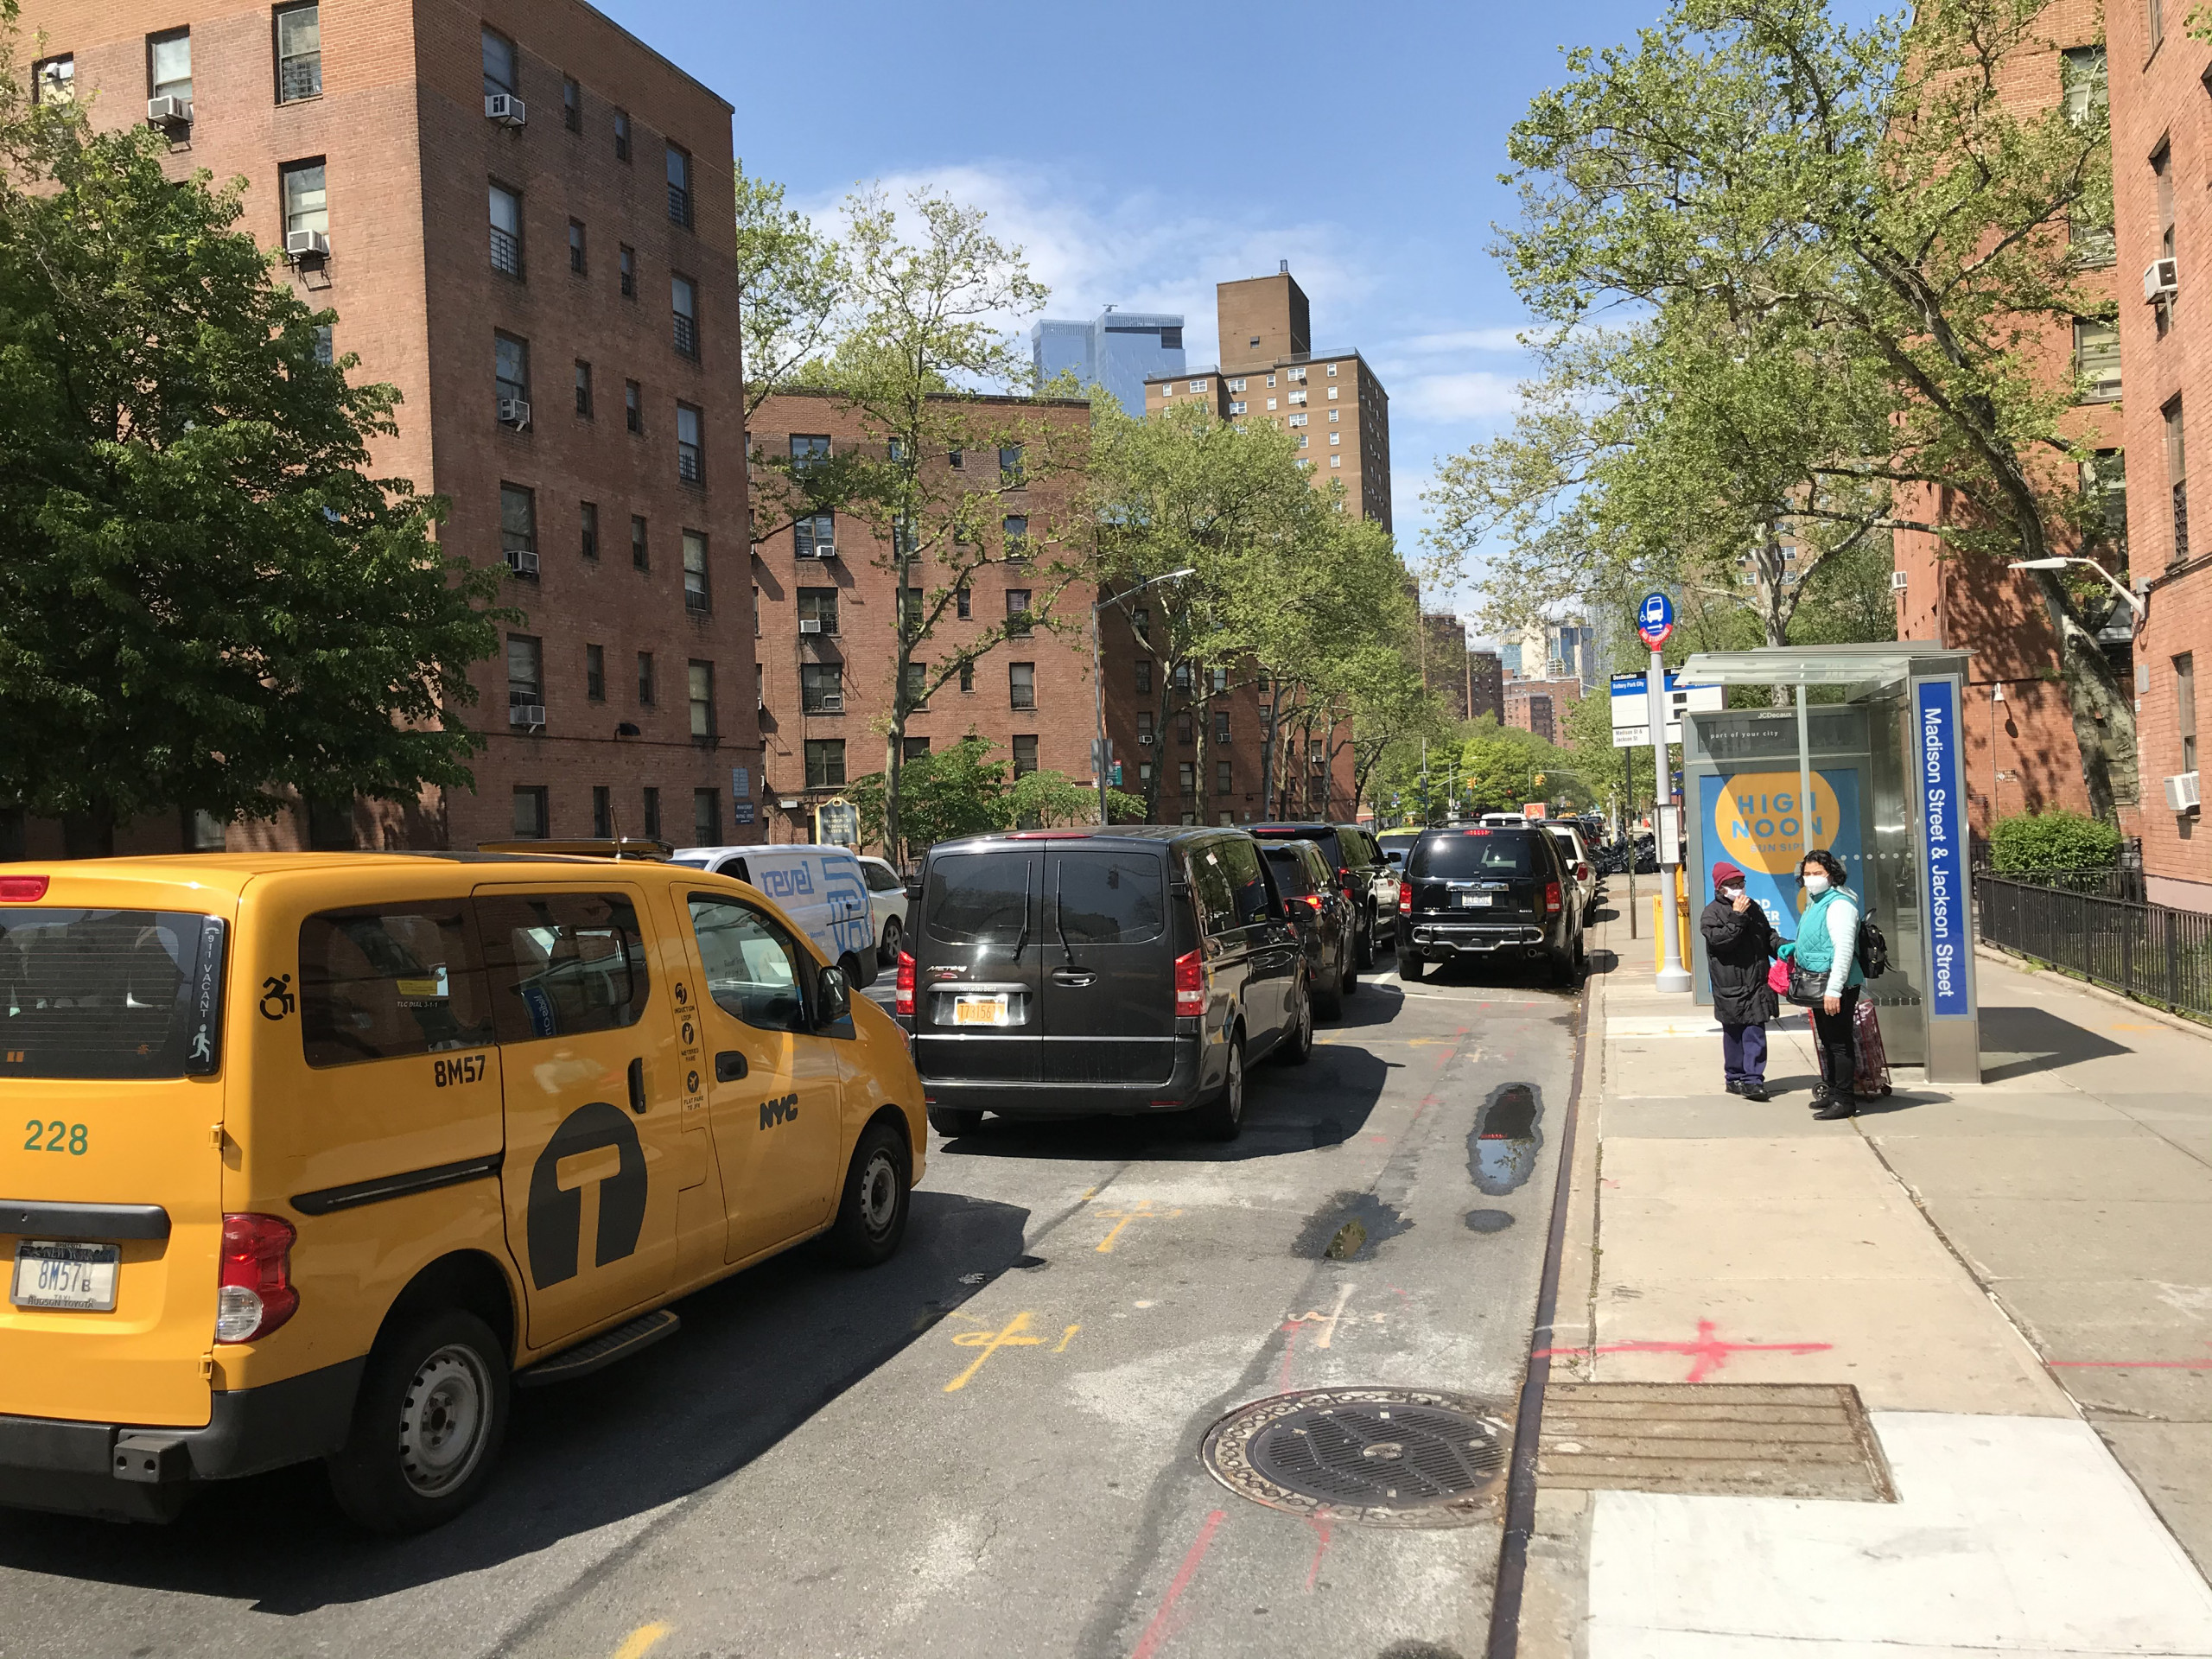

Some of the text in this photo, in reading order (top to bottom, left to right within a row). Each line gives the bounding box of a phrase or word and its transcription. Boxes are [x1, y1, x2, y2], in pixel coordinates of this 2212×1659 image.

[1732, 817, 1822, 839] NOON
[1750, 844, 1777, 854] SUN
[1924, 708, 1955, 997] Madison Street & Jackson Street
[760, 861, 815, 898] revel
[200, 964, 213, 1018] VACANT
[435, 1055, 486, 1087] 8M57
[760, 1093, 798, 1130] NYC
[23, 1119, 88, 1156] 228
[43, 1247, 94, 1262] NEW YORK
[38, 1260, 91, 1293] 8M57 B
[28, 1296, 94, 1309] HUDSON TOYOTA
